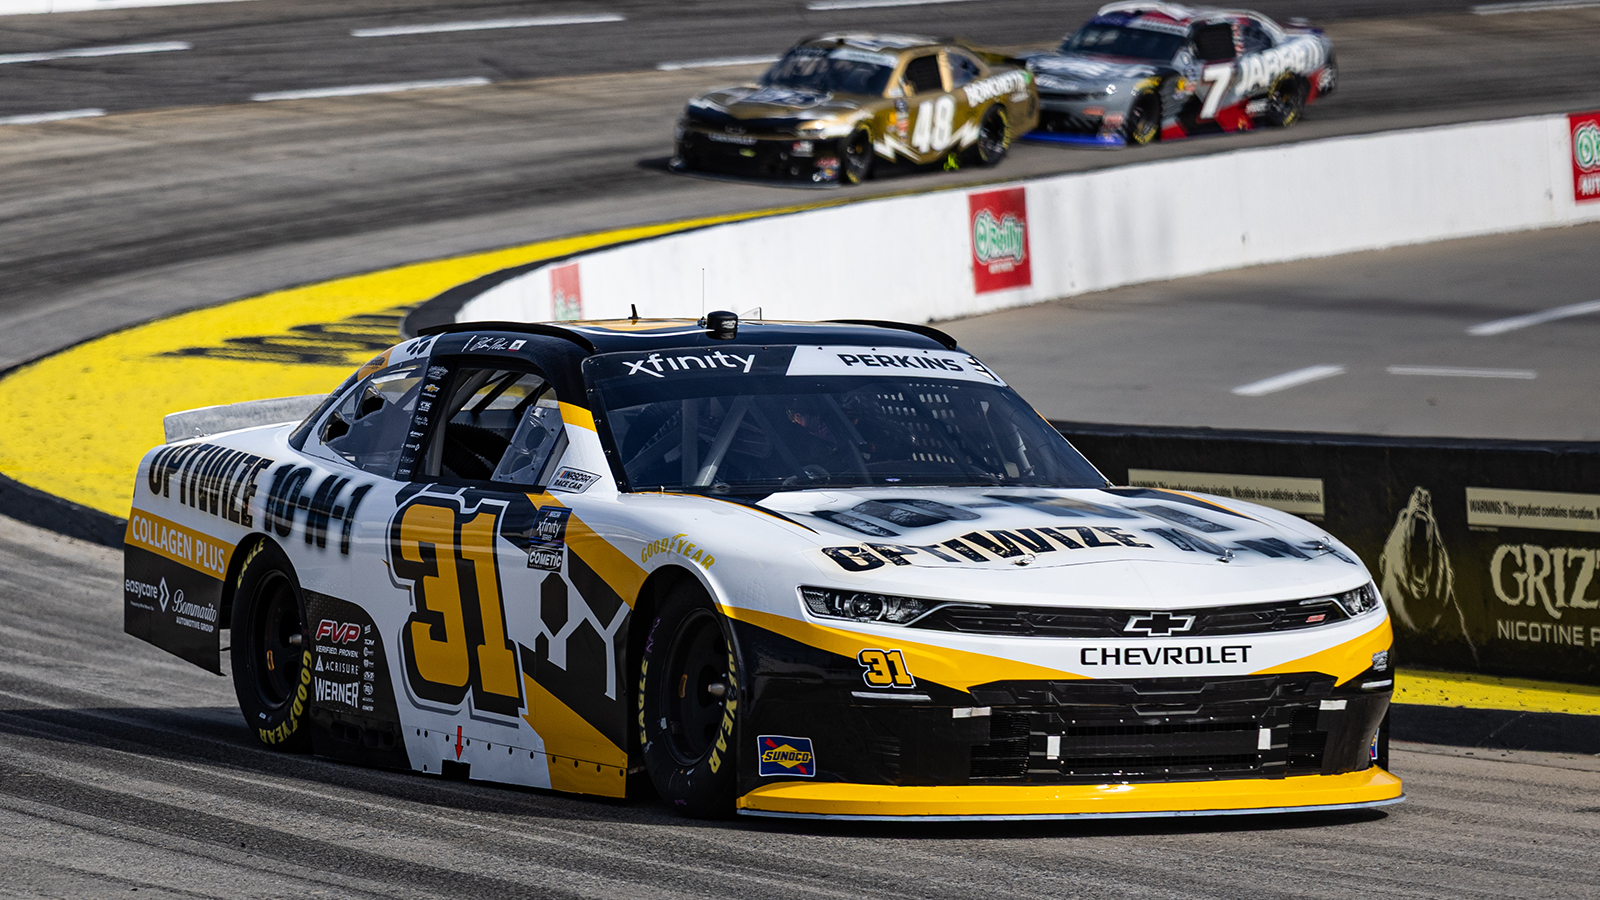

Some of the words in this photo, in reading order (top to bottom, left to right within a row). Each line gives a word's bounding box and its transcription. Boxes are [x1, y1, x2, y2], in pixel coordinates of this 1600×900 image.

[1200, 64, 1234, 119] 7
[912, 95, 956, 154] 48
[622, 350, 756, 378] xfinity
[836, 353, 966, 372] PERKINS
[148, 442, 275, 529] OPTIWIZE
[553, 479, 569, 488] RACE
[569, 481, 583, 490] CAR
[565, 470, 592, 483] NASCAR
[1469, 499, 1502, 514] WARNING:
[1503, 501, 1517, 516] This
[1517, 502, 1541, 519] product
[1541, 505, 1568, 518] contains
[1569, 505, 1596, 520] nicotine.
[537, 517, 562, 538] xfinity
[132, 515, 192, 565] COLLAGEN
[196, 540, 226, 574] PLUS
[821, 525, 1155, 573] OPTIWIZE
[236, 537, 267, 589] EAGLE
[529, 551, 562, 568] COMETIC
[125, 578, 159, 599] easycare
[1490, 543, 1600, 619] GRIZ
[171, 588, 218, 623] Bommarito
[393, 497, 522, 714] 31
[175, 615, 201, 630] AUTOMOTIVE
[200, 621, 214, 633] GROUP
[315, 619, 361, 645] FVP
[1497, 619, 1585, 647] NICOTINE
[325, 660, 360, 676] ACRISURE
[857, 648, 917, 688] 31
[1079, 645, 1252, 666] CHEVROLET
[314, 675, 360, 709] WERNER
[638, 657, 650, 745] EAGLE
[763, 750, 811, 763] SUNOCO
